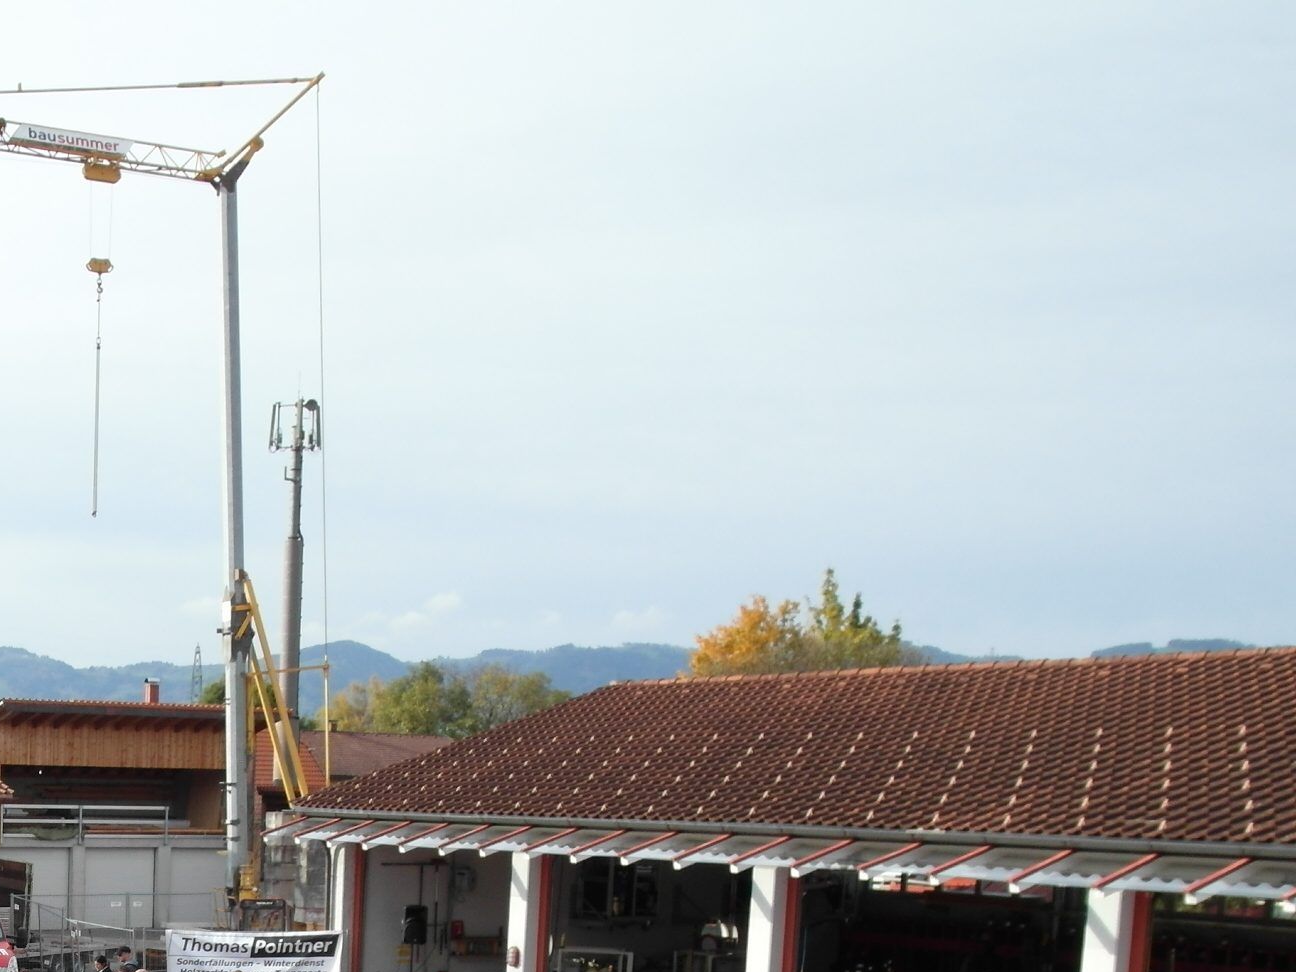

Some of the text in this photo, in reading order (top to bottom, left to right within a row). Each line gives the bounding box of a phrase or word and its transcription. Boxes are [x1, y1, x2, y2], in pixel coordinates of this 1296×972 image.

[28, 127, 119, 151] bausummer
[181, 937, 333, 954] Thomas Pointner
[263, 959, 324, 968] Winterdienst
